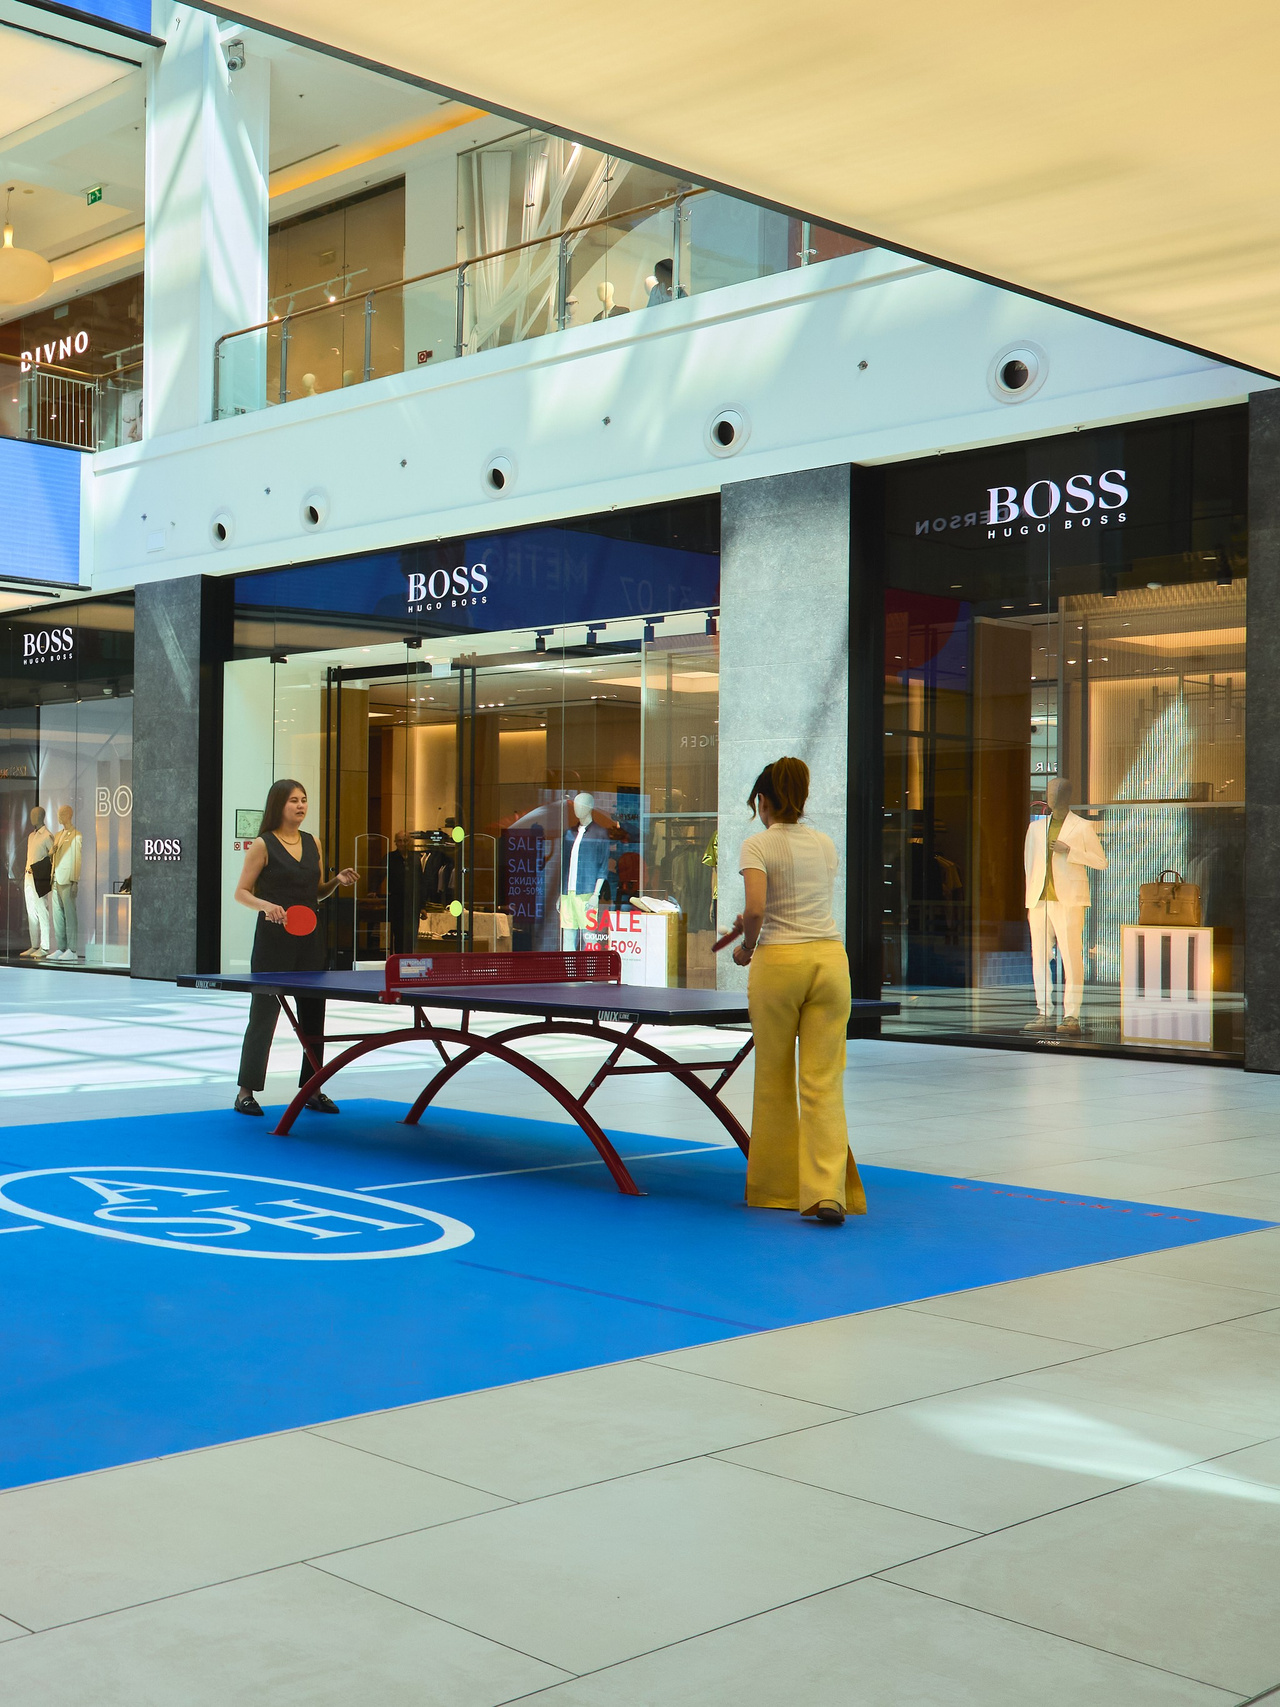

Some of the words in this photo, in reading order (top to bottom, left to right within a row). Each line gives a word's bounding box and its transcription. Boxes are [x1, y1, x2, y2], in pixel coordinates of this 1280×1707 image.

[20, 330, 89, 373] DIVNO
[986, 469, 1129, 526] BOSS
[987, 523, 1046, 540] HUGO
[1064, 513, 1127, 530] BOSS
[408, 563, 489, 602] BOSS
[408, 602, 442, 613] HUGO
[451, 596, 488, 608] BOSS
[23, 627, 74, 657] BOSS
[23, 656, 45, 666] HUGO
[50, 652, 73, 662] BOSS
[144, 839, 181, 855] BOSS
[508, 836, 544, 851] SALE
[508, 858, 544, 873] SALE
[508, 876, 544, 887] СКИДКИ
[508, 886, 520, 896] ДО
[508, 902, 544, 918] SALE
[585, 909, 642, 932] SALE
[598, 1010, 619, 1022] UNIX
